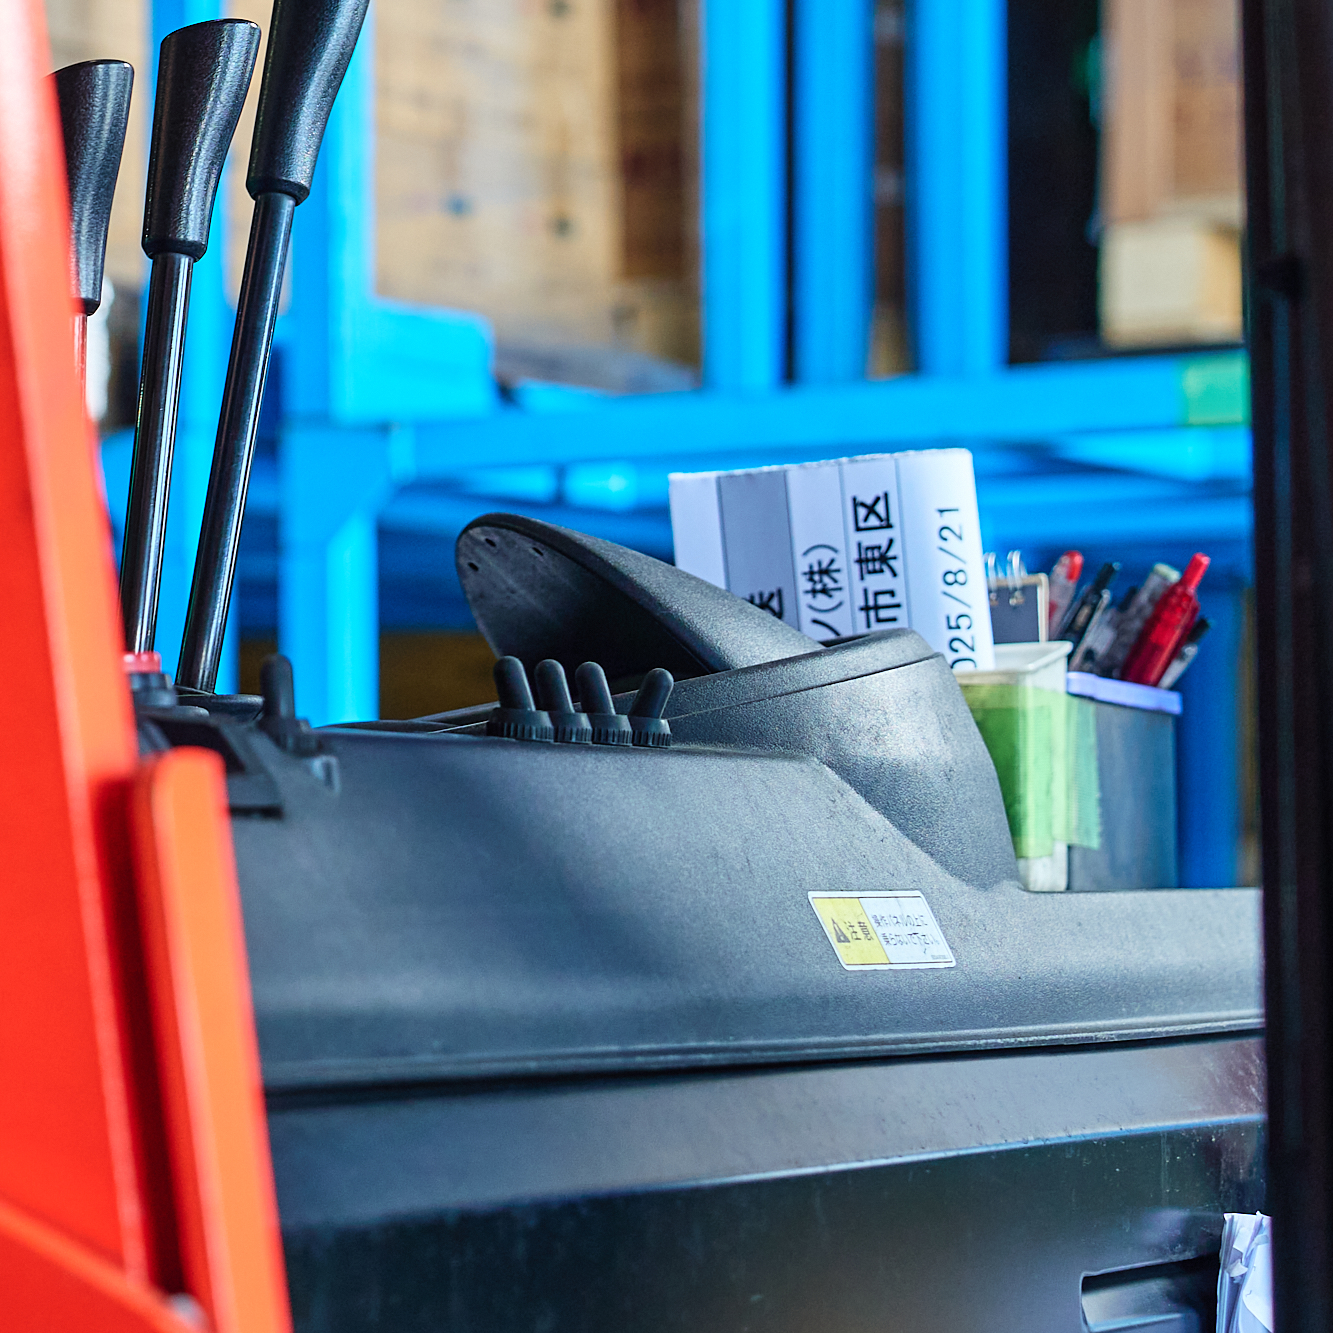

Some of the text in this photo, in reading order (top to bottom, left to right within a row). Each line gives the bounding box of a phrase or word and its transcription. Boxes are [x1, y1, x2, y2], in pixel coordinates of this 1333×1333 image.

[852, 491, 903, 629] 市東区
[843, 920, 874, 942] 注意
